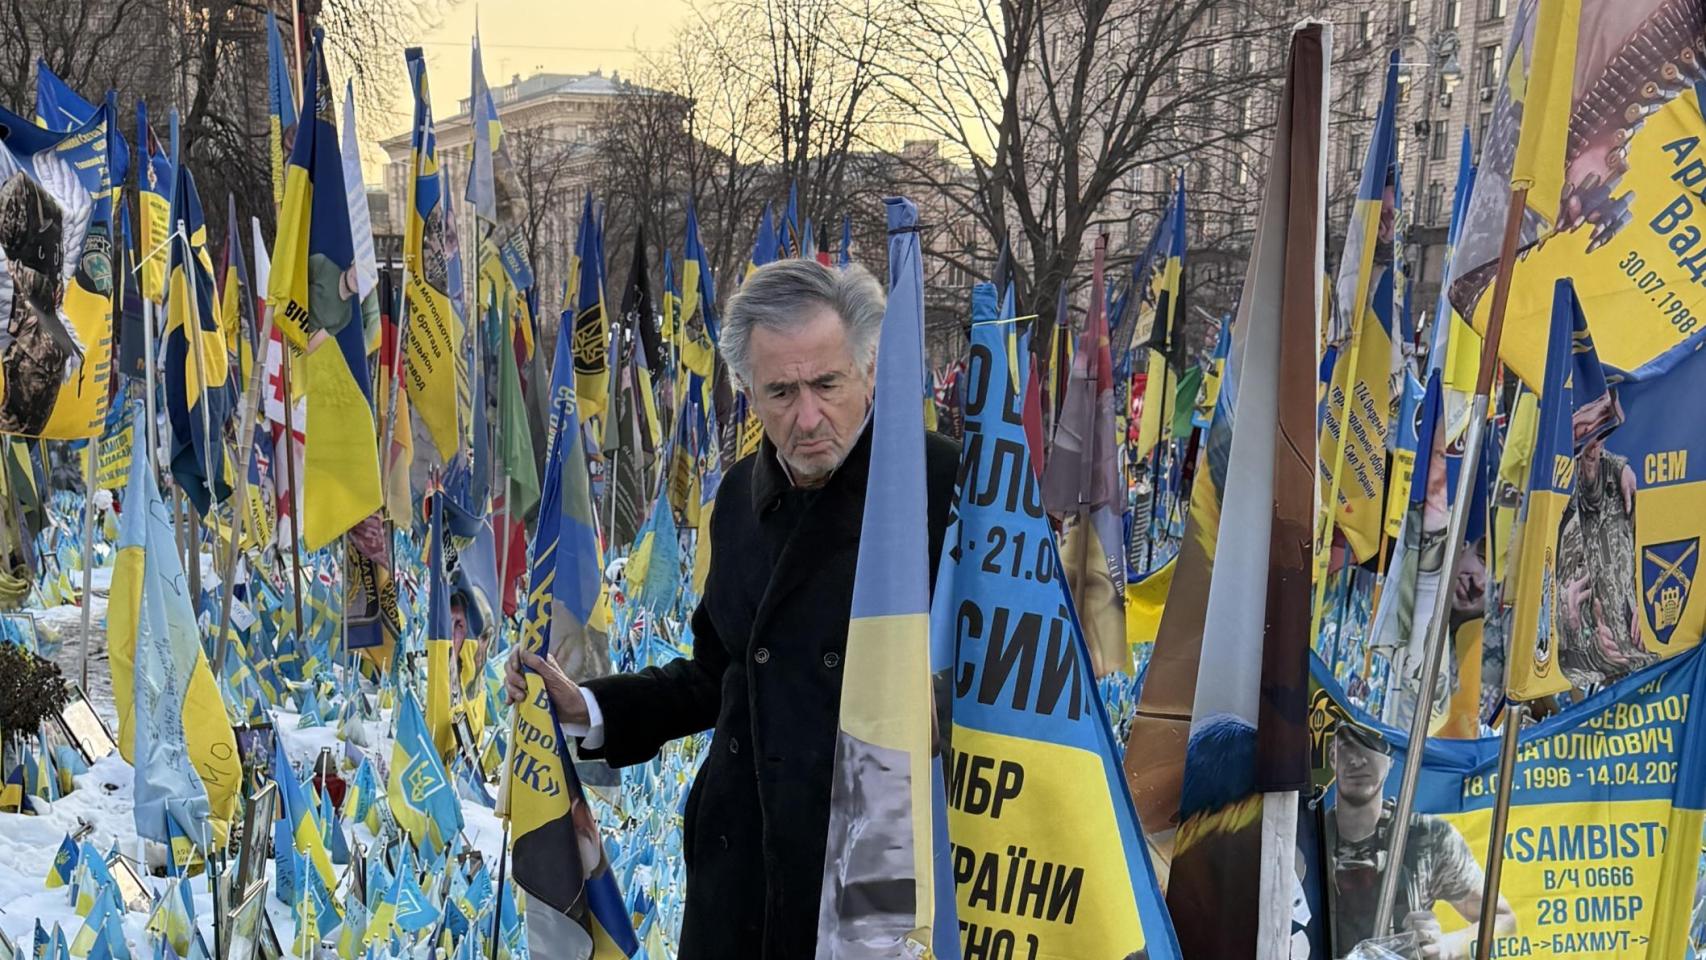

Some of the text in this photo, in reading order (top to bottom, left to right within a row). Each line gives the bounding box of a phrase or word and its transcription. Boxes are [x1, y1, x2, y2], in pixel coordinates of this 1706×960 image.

[284, 299, 308, 333] ВІЧ
[408, 325, 433, 374] тальйон
[1353, 380, 1386, 437] 114 Окрема
[981, 525, 1062, 590] 21.0
[951, 843, 1085, 925] РАЇНИ
[1543, 868, 1580, 891] В/Ч
[1536, 899, 1568, 926] 28
